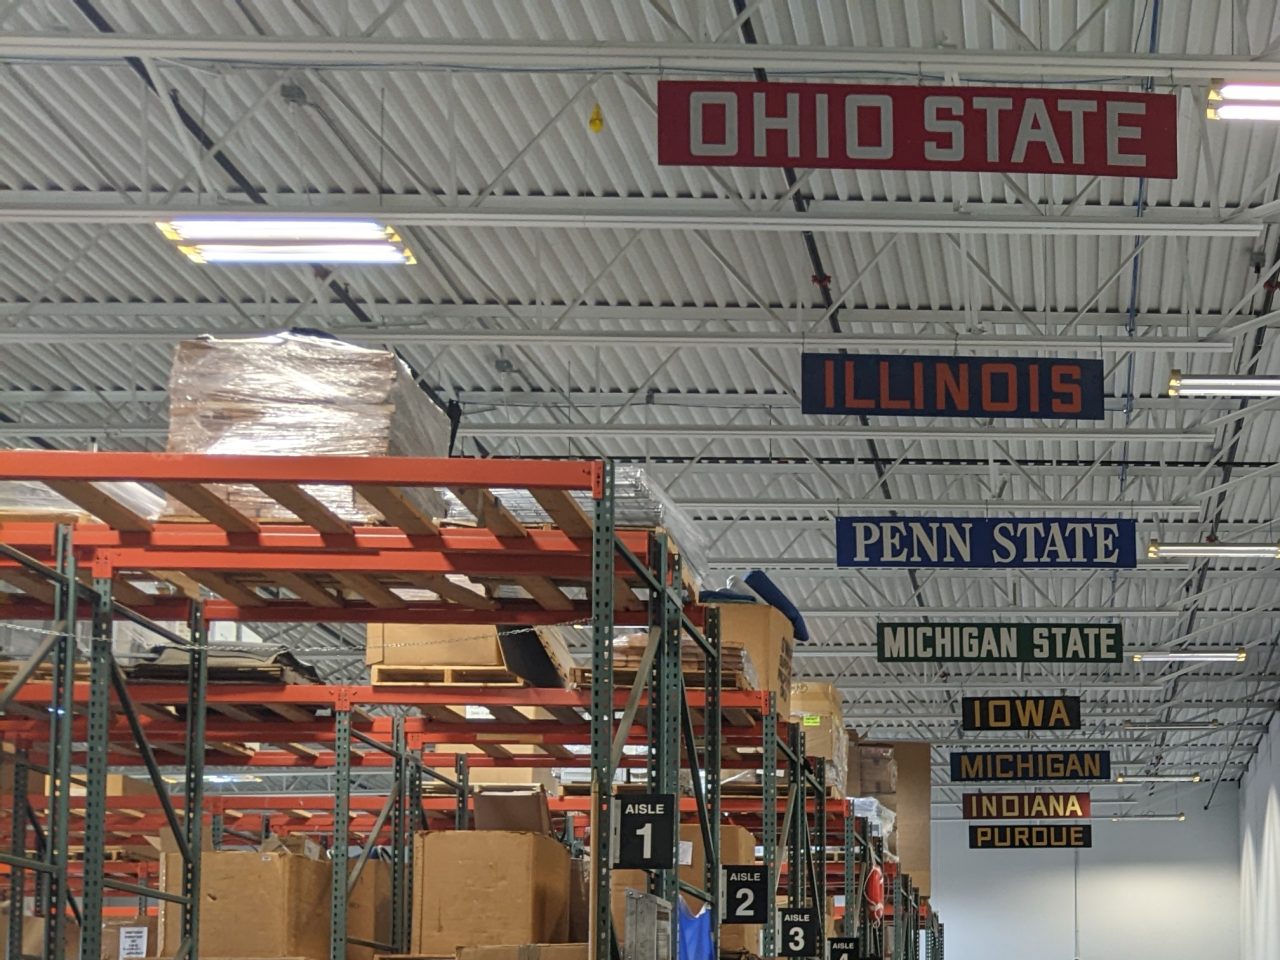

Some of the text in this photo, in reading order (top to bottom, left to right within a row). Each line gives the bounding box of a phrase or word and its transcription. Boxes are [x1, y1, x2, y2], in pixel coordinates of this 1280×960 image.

[689, 91, 1148, 167] OHIO STATE
[825, 359, 1083, 414] ILLINOIS
[852, 522, 1119, 564] PENN STATE
[883, 626, 1117, 659] MICHIGAN STATE
[973, 699, 1071, 728] IOWA
[960, 752, 1101, 779] MICHIGAN
[625, 803, 665, 815] AISLE
[971, 794, 1083, 818] INDIANA
[635, 822, 653, 860] 1
[977, 826, 1084, 847] PURDUE
[729, 872, 761, 882] AISLE
[735, 888, 755, 917] 2
[784, 913, 810, 922] AISLE
[788, 927, 806, 951] 3
[832, 942, 854, 950] AISLE
